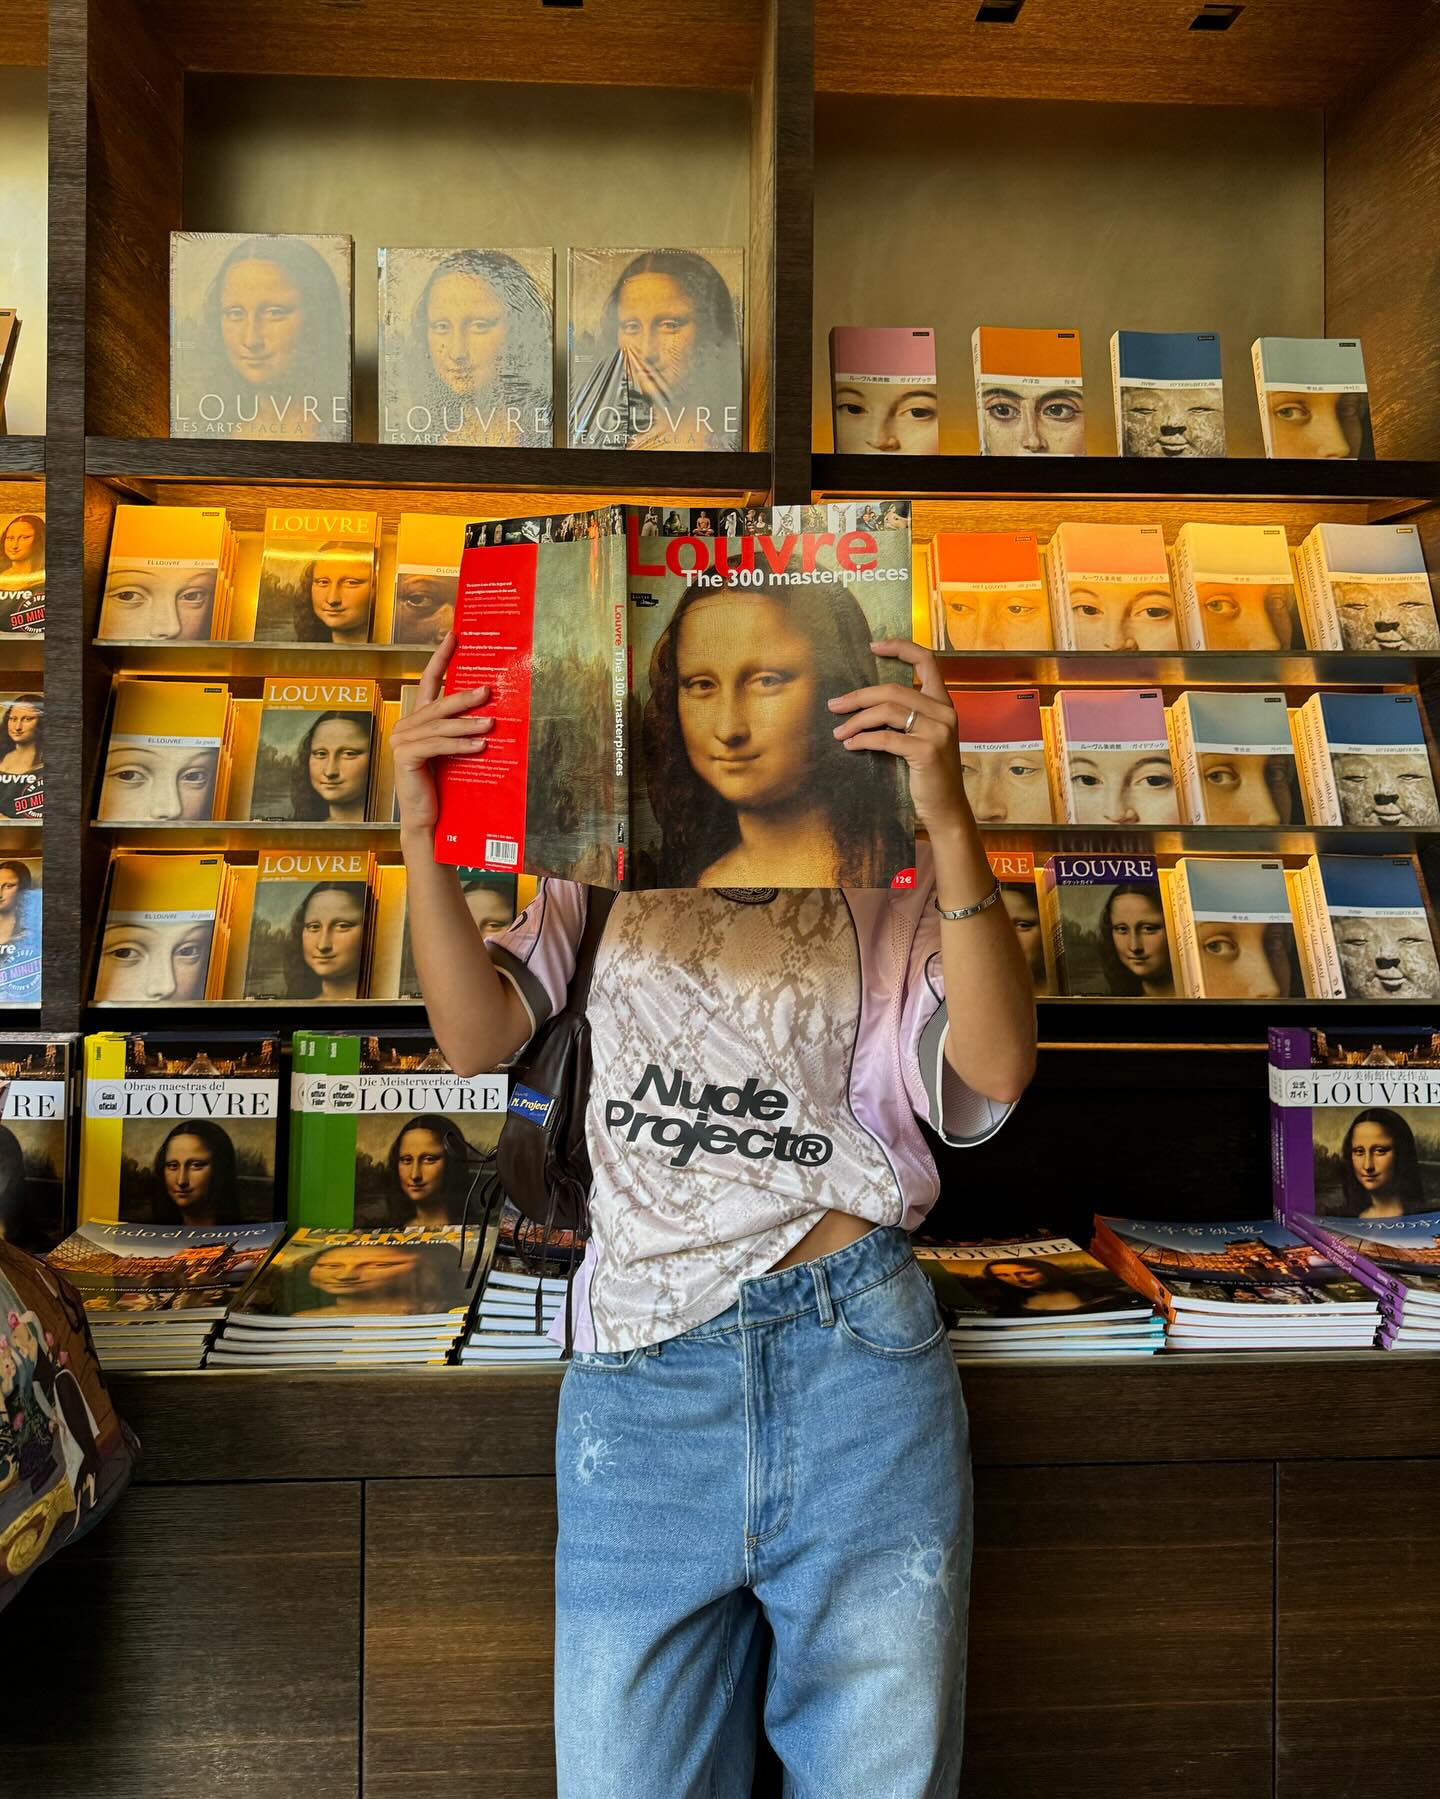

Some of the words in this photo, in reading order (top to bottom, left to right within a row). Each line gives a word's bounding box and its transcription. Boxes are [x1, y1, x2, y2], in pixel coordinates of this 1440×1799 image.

[176, 394, 347, 423] LOUVRE
[175, 422, 198, 433] LES
[205, 422, 242, 433] ARTS
[385, 405, 551, 433] LOUVRE
[575, 406, 739, 433] LOUVRE
[603, 434, 638, 445] ARTS
[272, 515, 370, 534] LOUVRE
[627, 512, 879, 578] Louvre
[681, 568, 722, 588] The
[727, 568, 764, 588] 300
[769, 565, 909, 588] masterpieces
[11, 614, 24, 626] 90
[614, 604, 625, 646] Louvre
[615, 649, 625, 673] The
[269, 685, 368, 703] LOUVRE
[614, 674, 625, 697] 300
[613, 700, 626, 777] masterpieces
[15, 799, 28, 812] 90
[263, 855, 362, 873] LOUVRE
[989, 857, 1030, 874] VRE
[1059, 860, 1154, 878] LOUVRE
[895, 876, 912, 884] 12€
[359, 1077, 378, 1086] Die
[380, 1076, 451, 1087] Meisterwerke
[453, 1077, 471, 1086] des
[1311, 1070, 1430, 1081] ルーヴル美術館代表作品
[124, 1081, 157, 1091] Obras
[158, 1082, 207, 1091] maestras
[209, 1081, 225, 1091] del
[631, 1063, 789, 1121] Nude
[1289, 1090, 1309, 1099] ガイド
[1312, 1082, 1440, 1105] LOUVRE
[125, 1092, 270, 1116] LOUVRE
[359, 1088, 500, 1111] LOUVRE
[520, 1099, 550, 1111] Project
[101, 1225, 156, 1237] Todo
[161, 1230, 182, 1239] el
[187, 1229, 267, 1239] Louvre
[294, 1226, 475, 1243] Louvre
[929, 1243, 1074, 1260] LOUVRE
